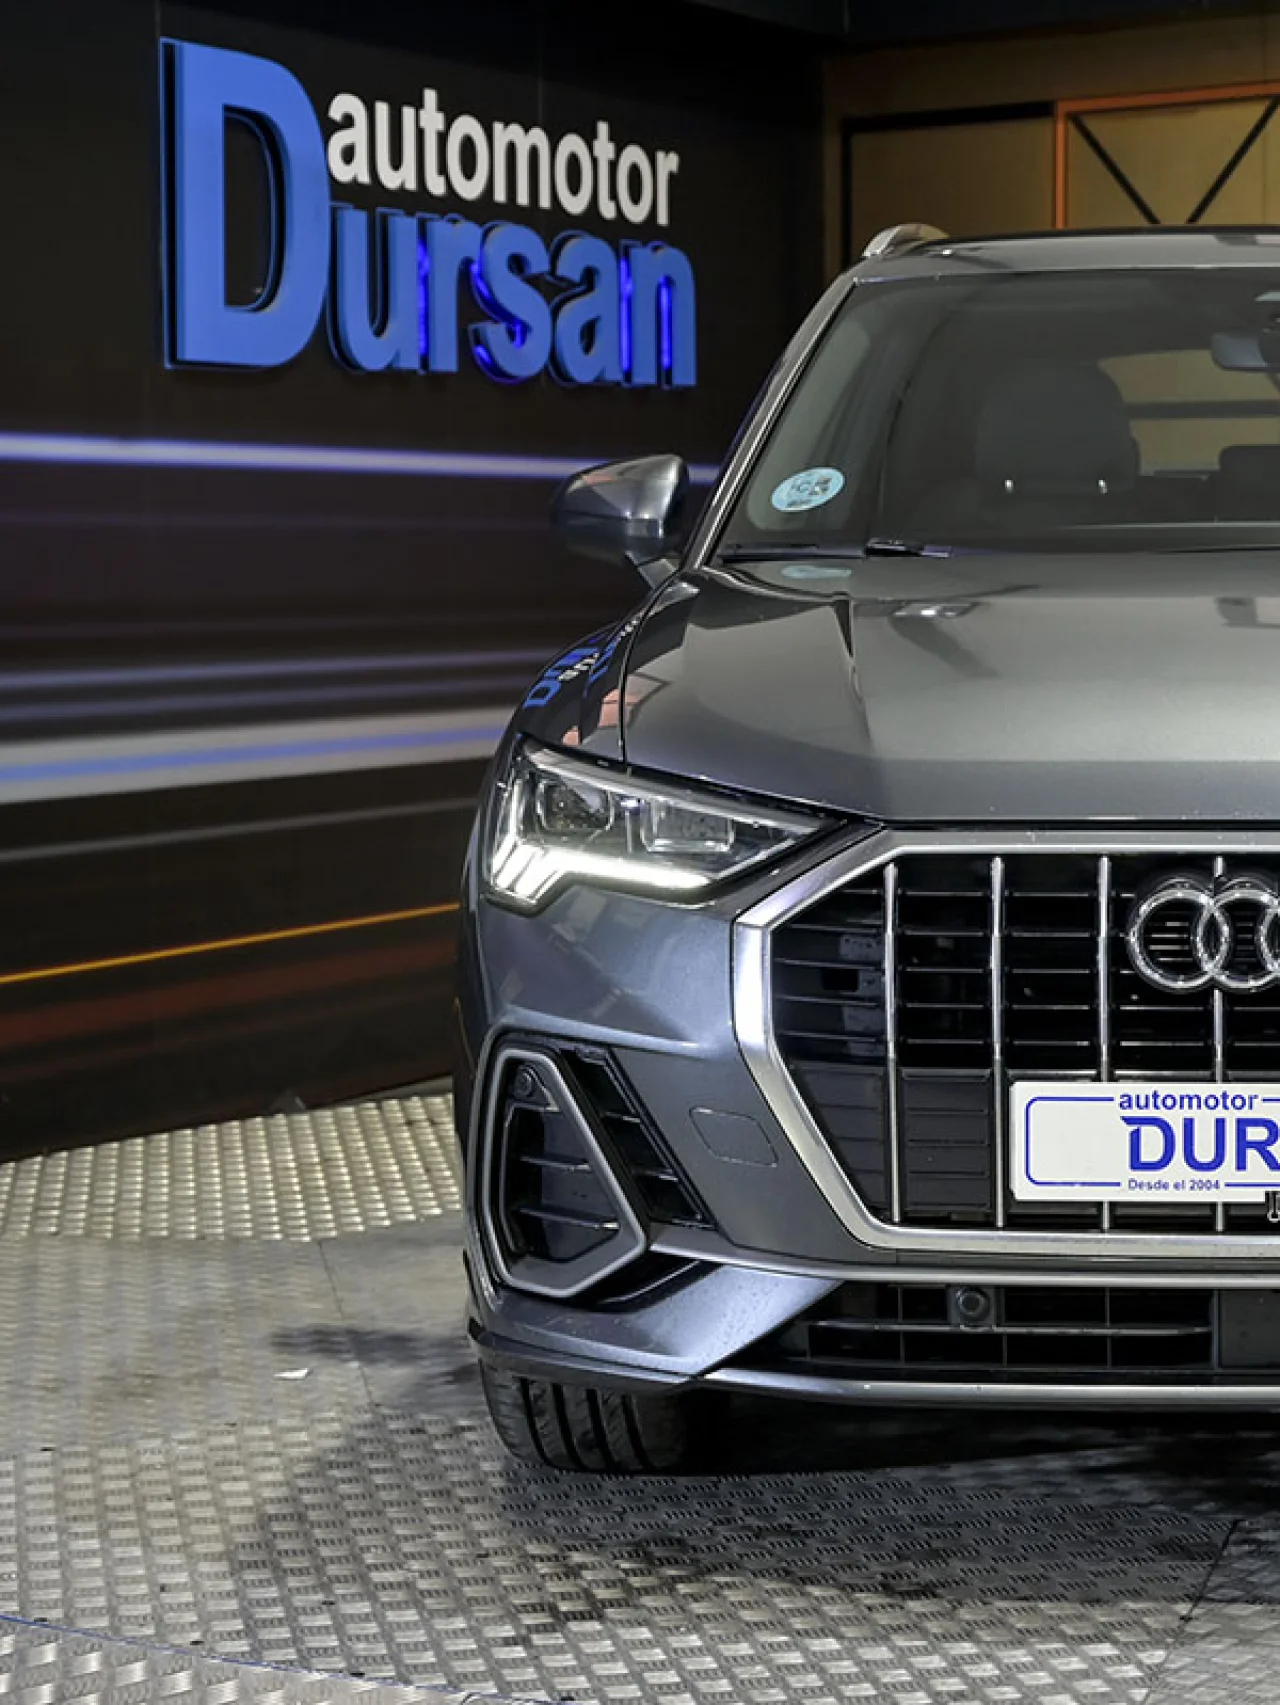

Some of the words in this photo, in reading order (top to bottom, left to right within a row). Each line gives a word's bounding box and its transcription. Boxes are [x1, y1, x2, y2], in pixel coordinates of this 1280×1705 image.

[327, 88, 679, 226] automotor
[159, 36, 697, 389] Dursan
[1118, 1090, 1259, 1111] automotor
[1128, 1178, 1169, 1191] Desde
[1173, 1179, 1186, 1191] el
[1189, 1178, 1220, 1191] 2004
